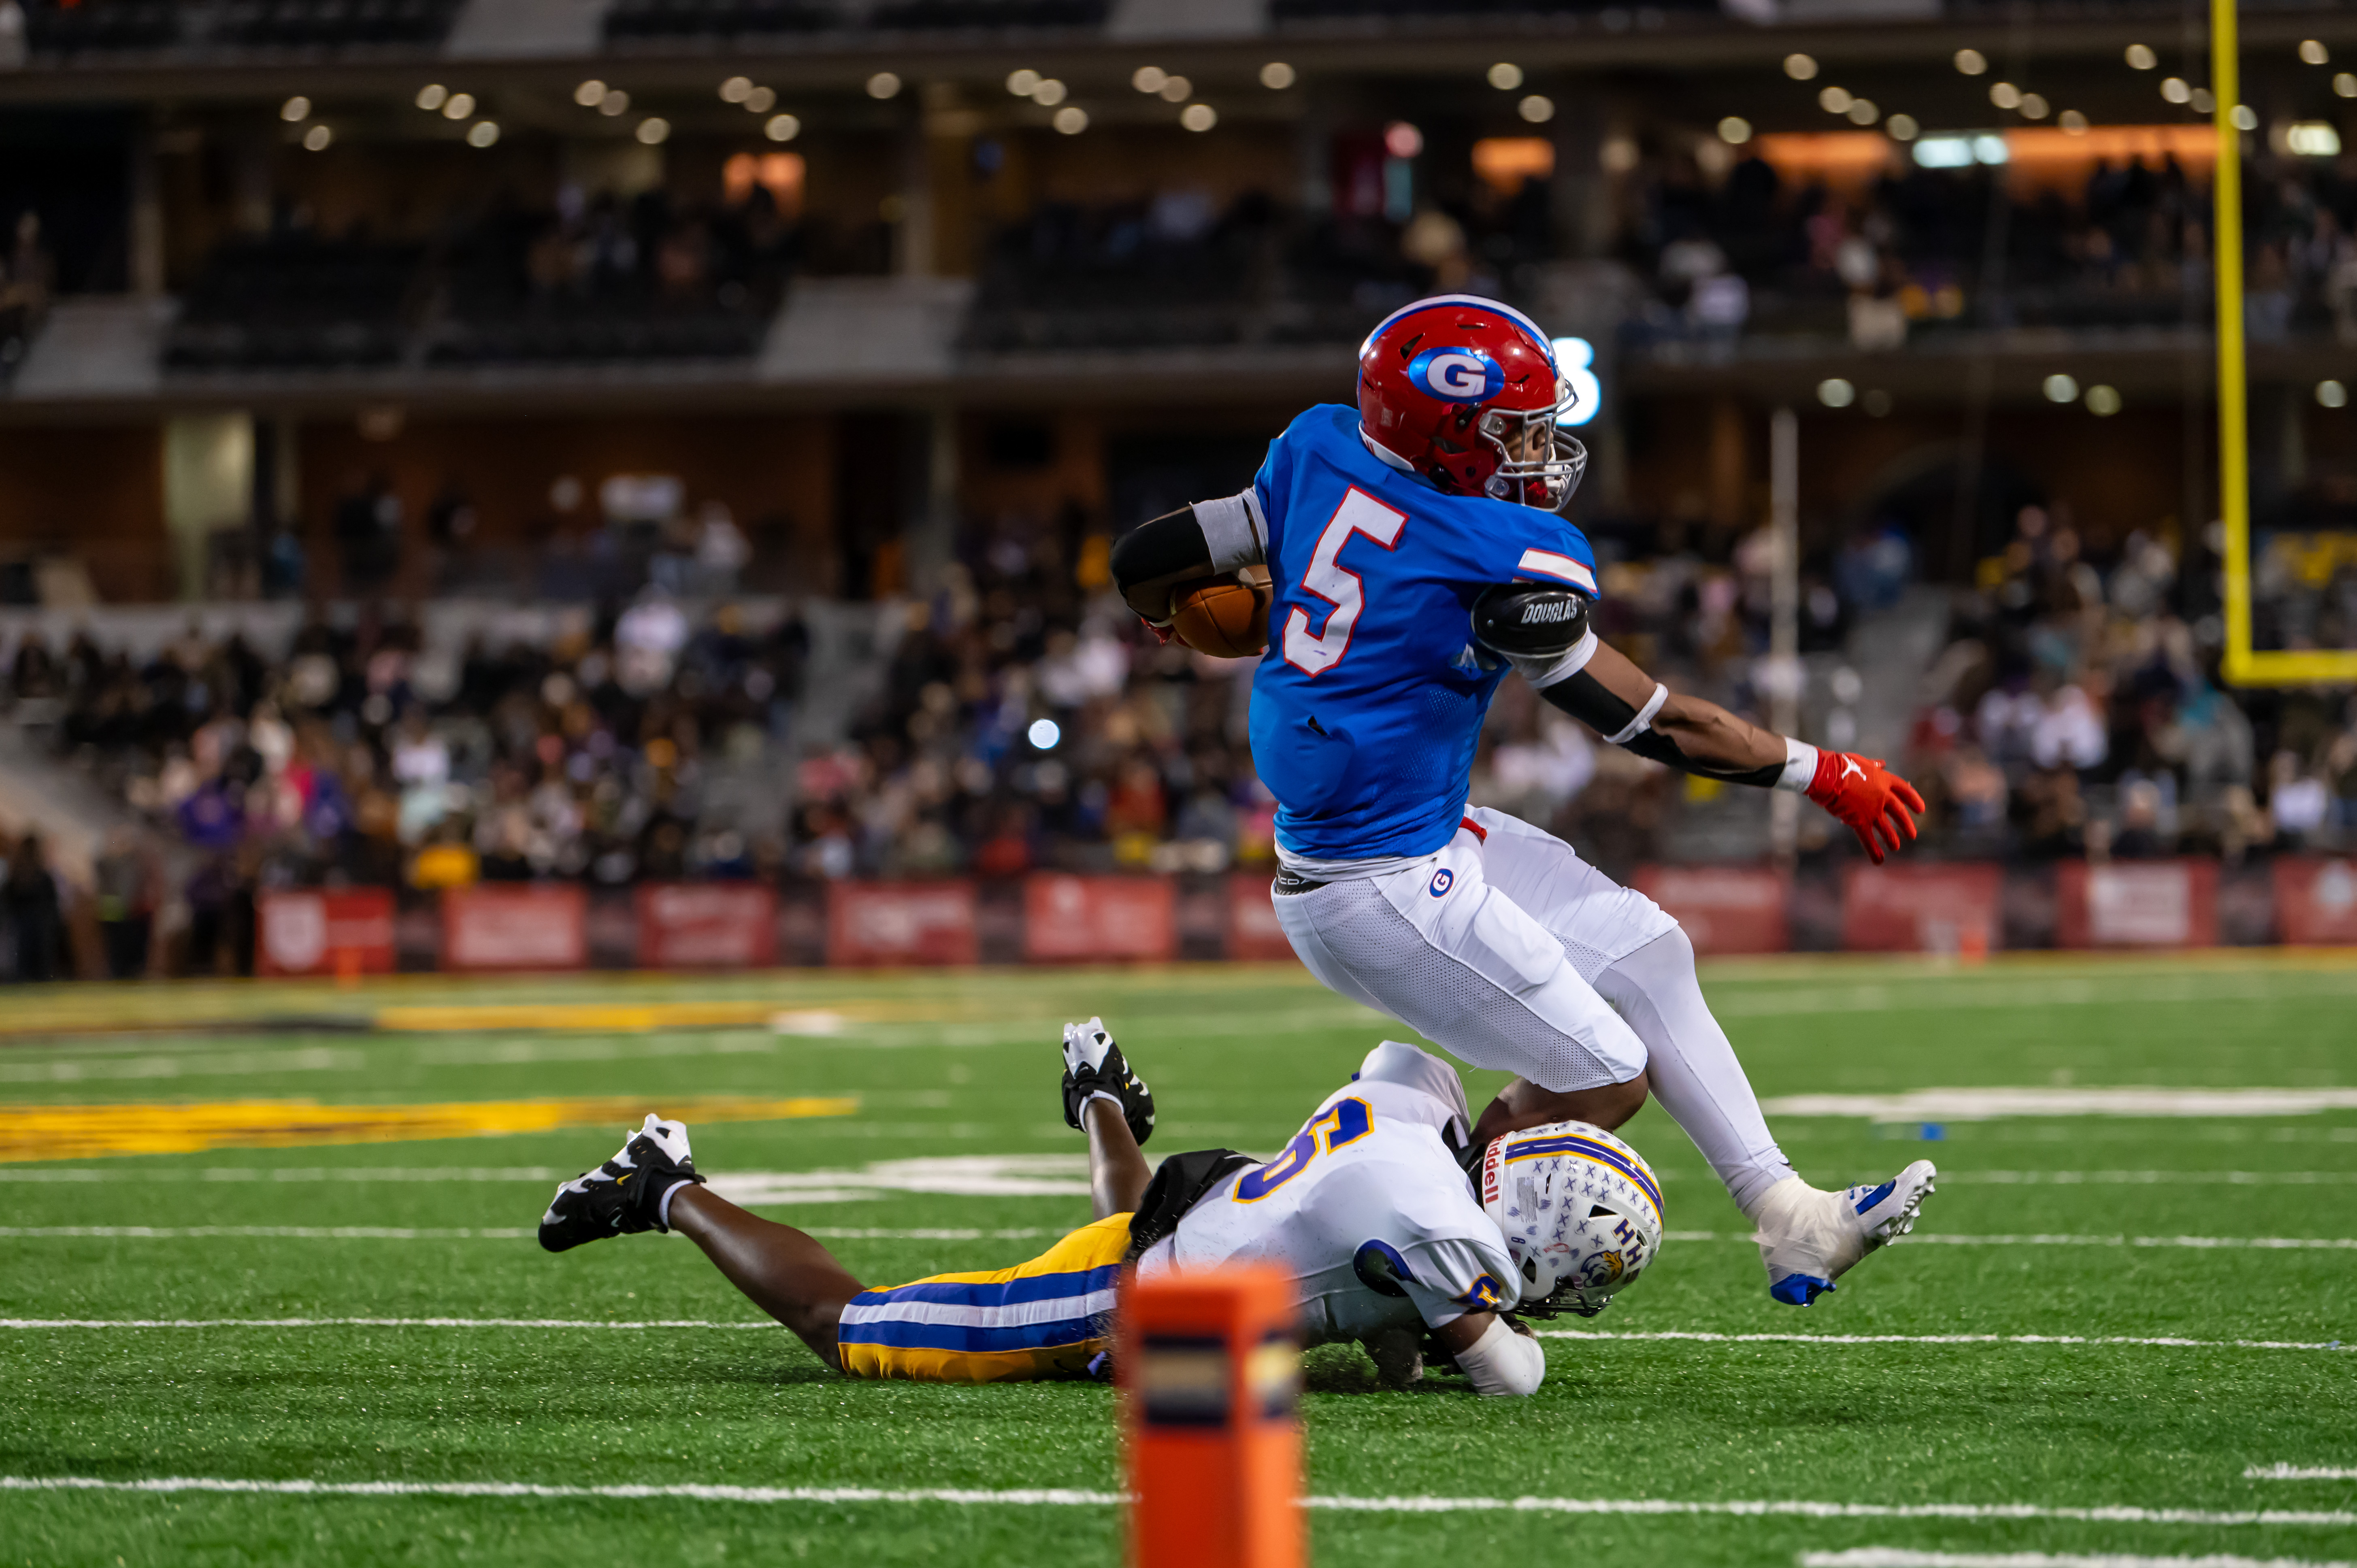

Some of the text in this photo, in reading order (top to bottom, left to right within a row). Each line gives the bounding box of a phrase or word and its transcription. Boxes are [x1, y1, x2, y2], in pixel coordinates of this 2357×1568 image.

[1427, 353, 1486, 397] G
[1282, 483, 1410, 679] 5
[1521, 598, 1578, 624] DOUGLAS
[1433, 873, 1450, 891] G
[1232, 1096, 1375, 1204] 6
